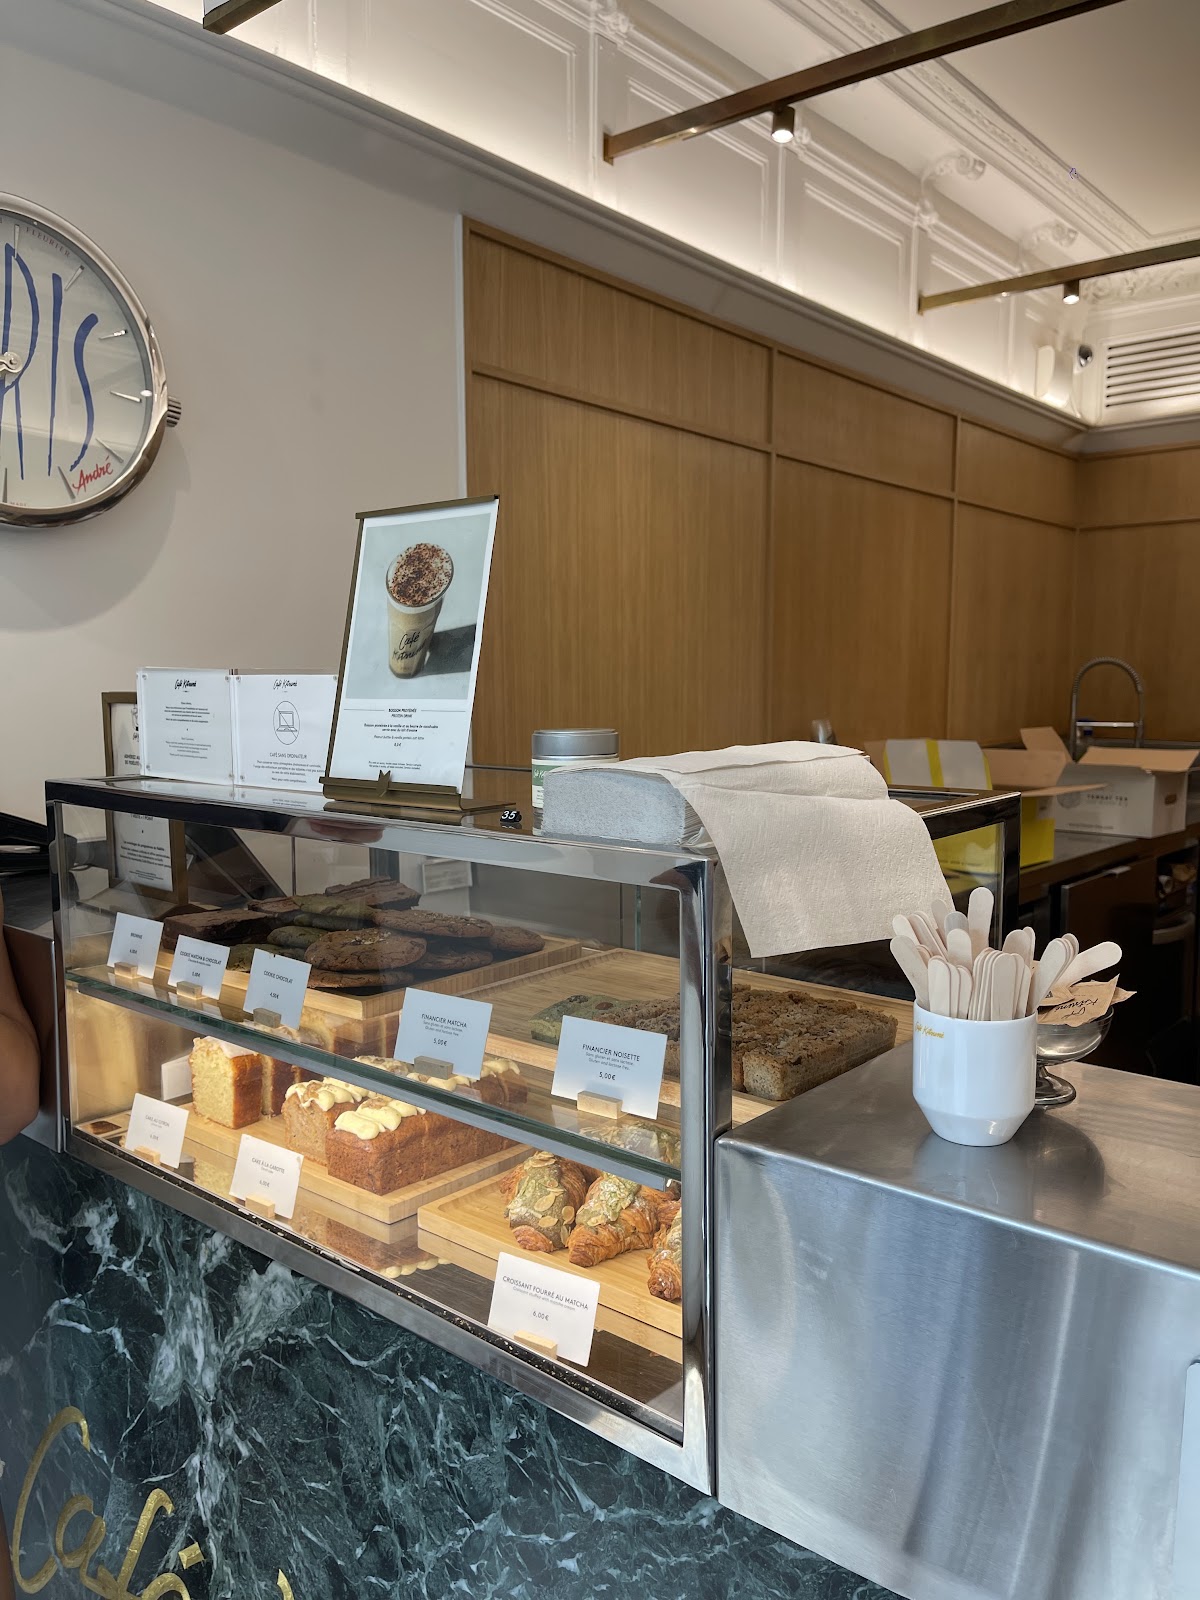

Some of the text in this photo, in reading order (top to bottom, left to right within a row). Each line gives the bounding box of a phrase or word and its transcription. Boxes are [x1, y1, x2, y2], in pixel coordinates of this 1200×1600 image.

[25, 227, 71, 257] FLEURIER
[0, 243, 98, 480] RIS
[72, 455, 113, 495] André
[399, 631, 420, 651] Café
[502, 811, 517, 820] 35
[264, 970, 293, 984] COOKIE CHOCOLAT
[422, 1013, 467, 1028] FINANCIER MATCHA
[433, 1038, 448, 1046] 5,00€
[582, 1044, 640, 1062] FINANCIER NOISETTE
[599, 1071, 616, 1080] 5,00€
[251, 1157, 261, 1165] CAKE
[269, 1164, 285, 1174] CAROTTE
[502, 1276, 589, 1310] CROISSANT FOURRÉ AU MATCHA
[532, 1310, 550, 1322] 6,00€
